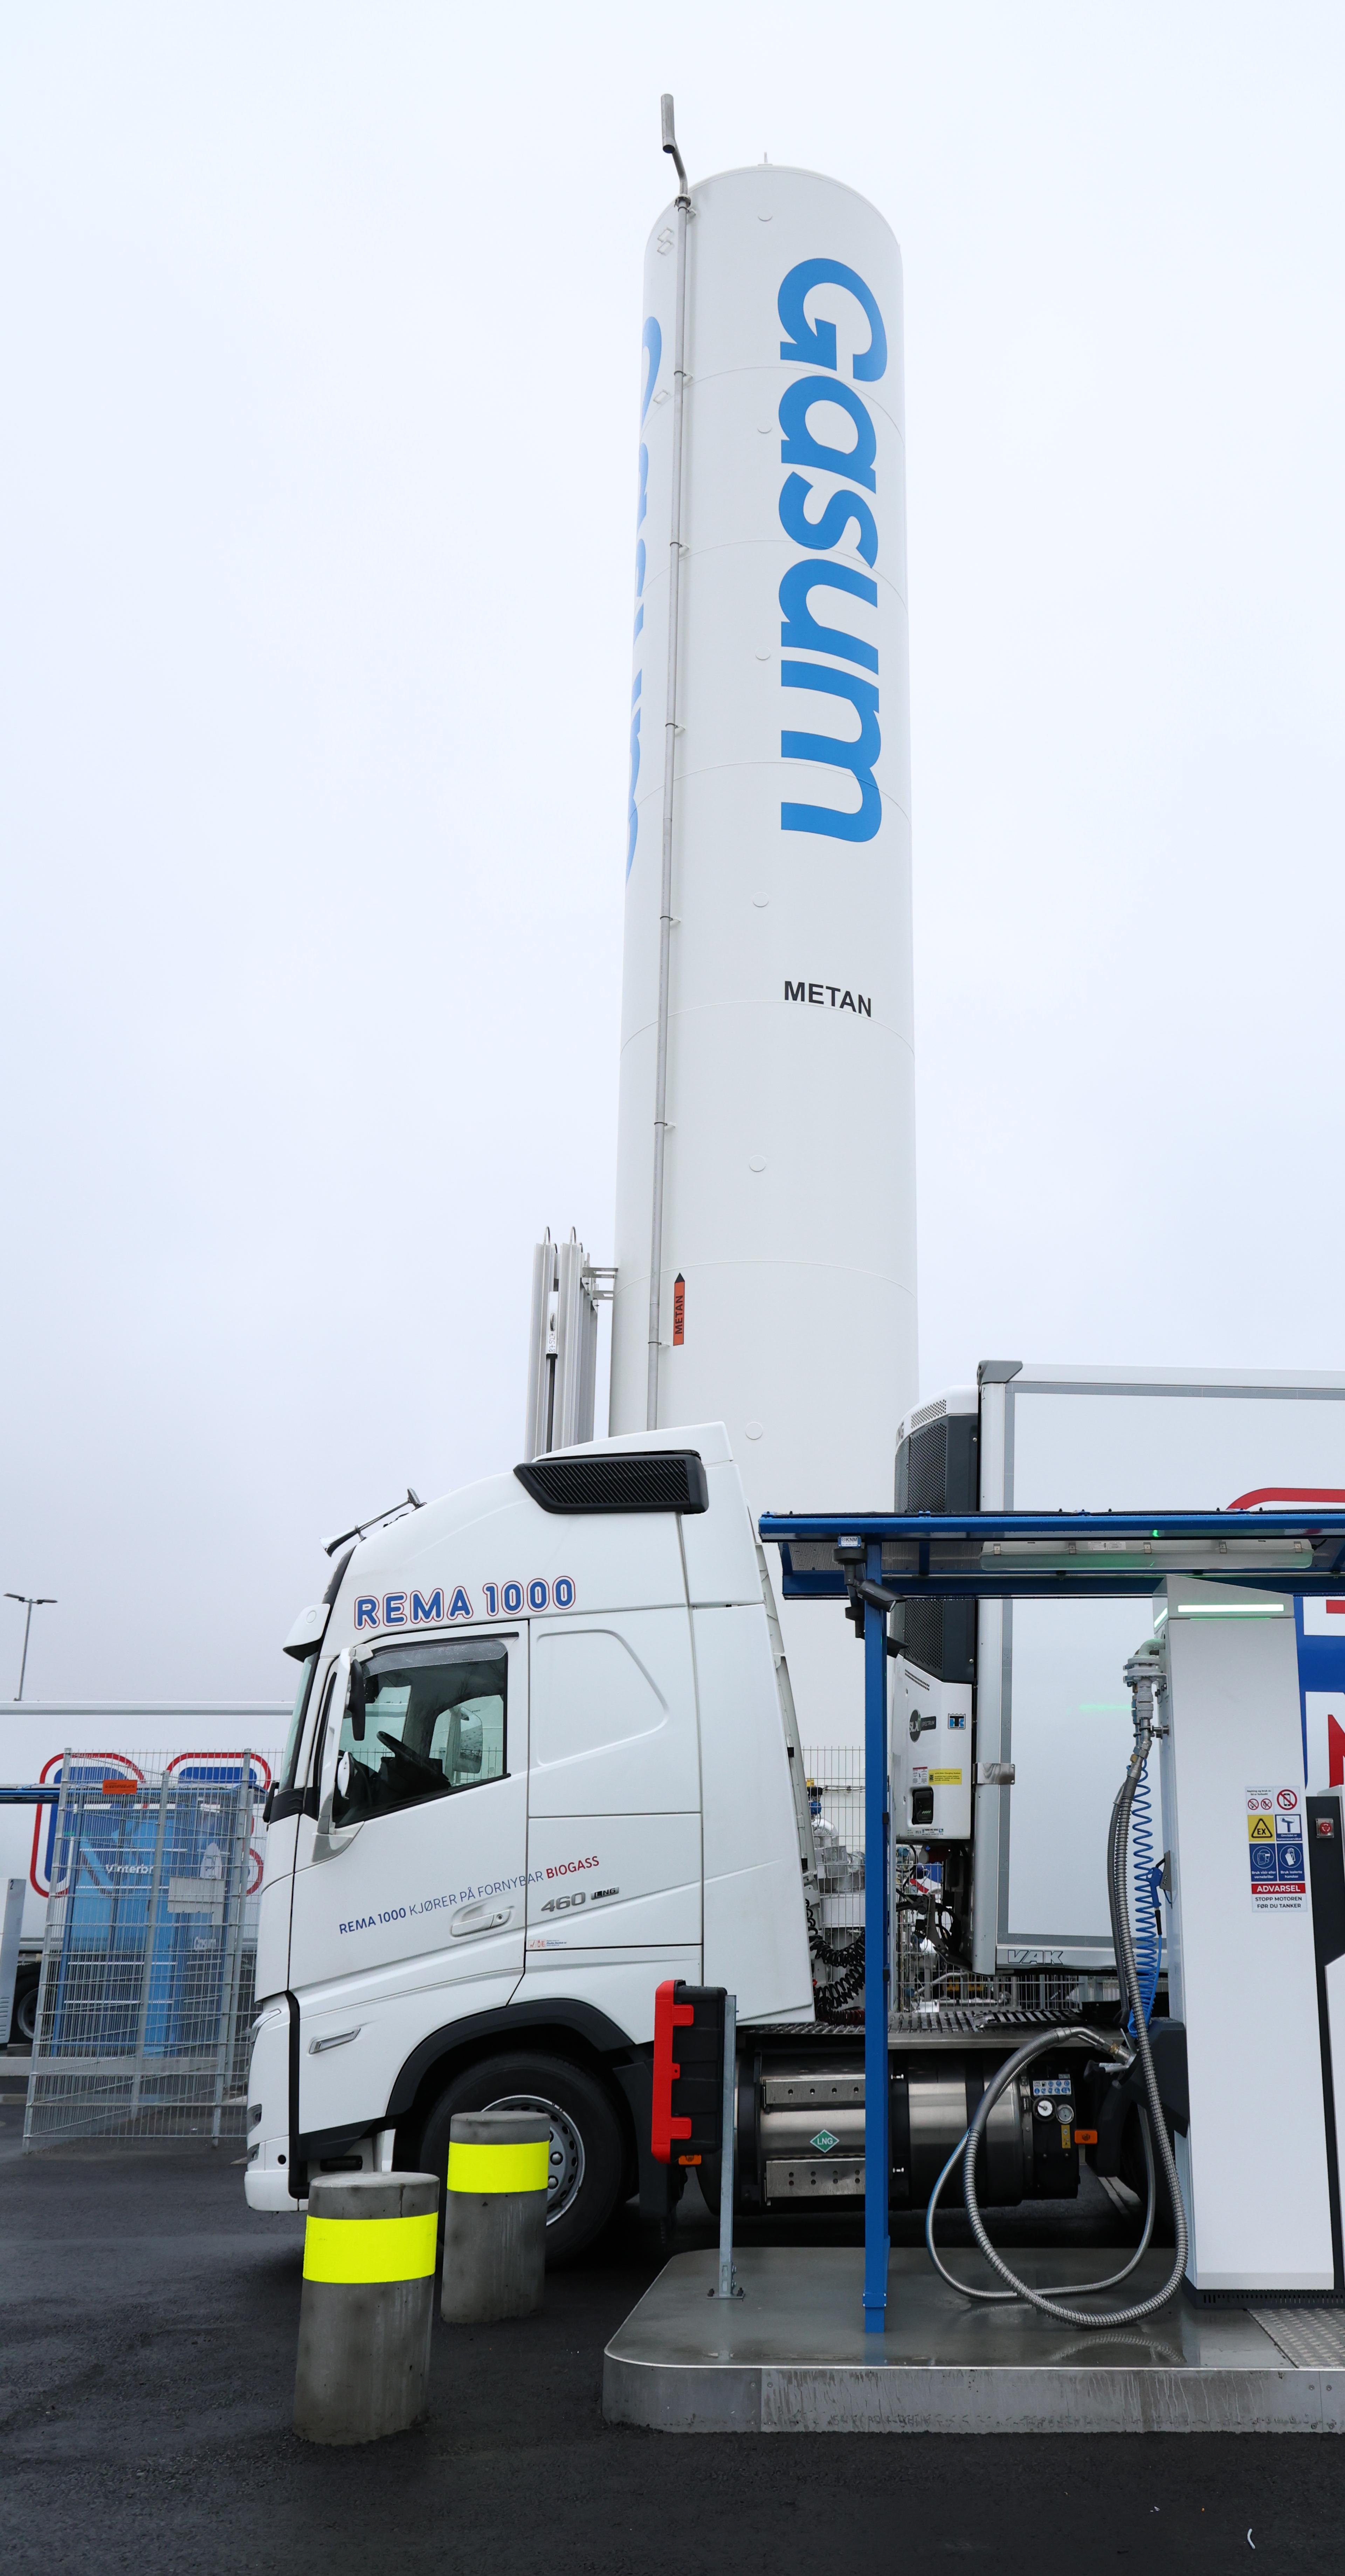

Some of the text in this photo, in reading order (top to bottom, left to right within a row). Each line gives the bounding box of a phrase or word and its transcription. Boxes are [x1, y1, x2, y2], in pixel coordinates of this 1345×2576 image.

[778, 258, 888, 843] Gasum
[784, 981, 871, 1018] METAN
[675, 1295, 683, 1335] METAN
[354, 1576, 575, 1630] REMA 1000
[10, 1880, 14, 1890] 2
[339, 1856, 600, 1935] REMA 1000 KJØRER PÅ FORNYBAR BIOGASS
[541, 1888, 616, 1912] 460 LNG
[1008, 1950, 1063, 1965] VAK
